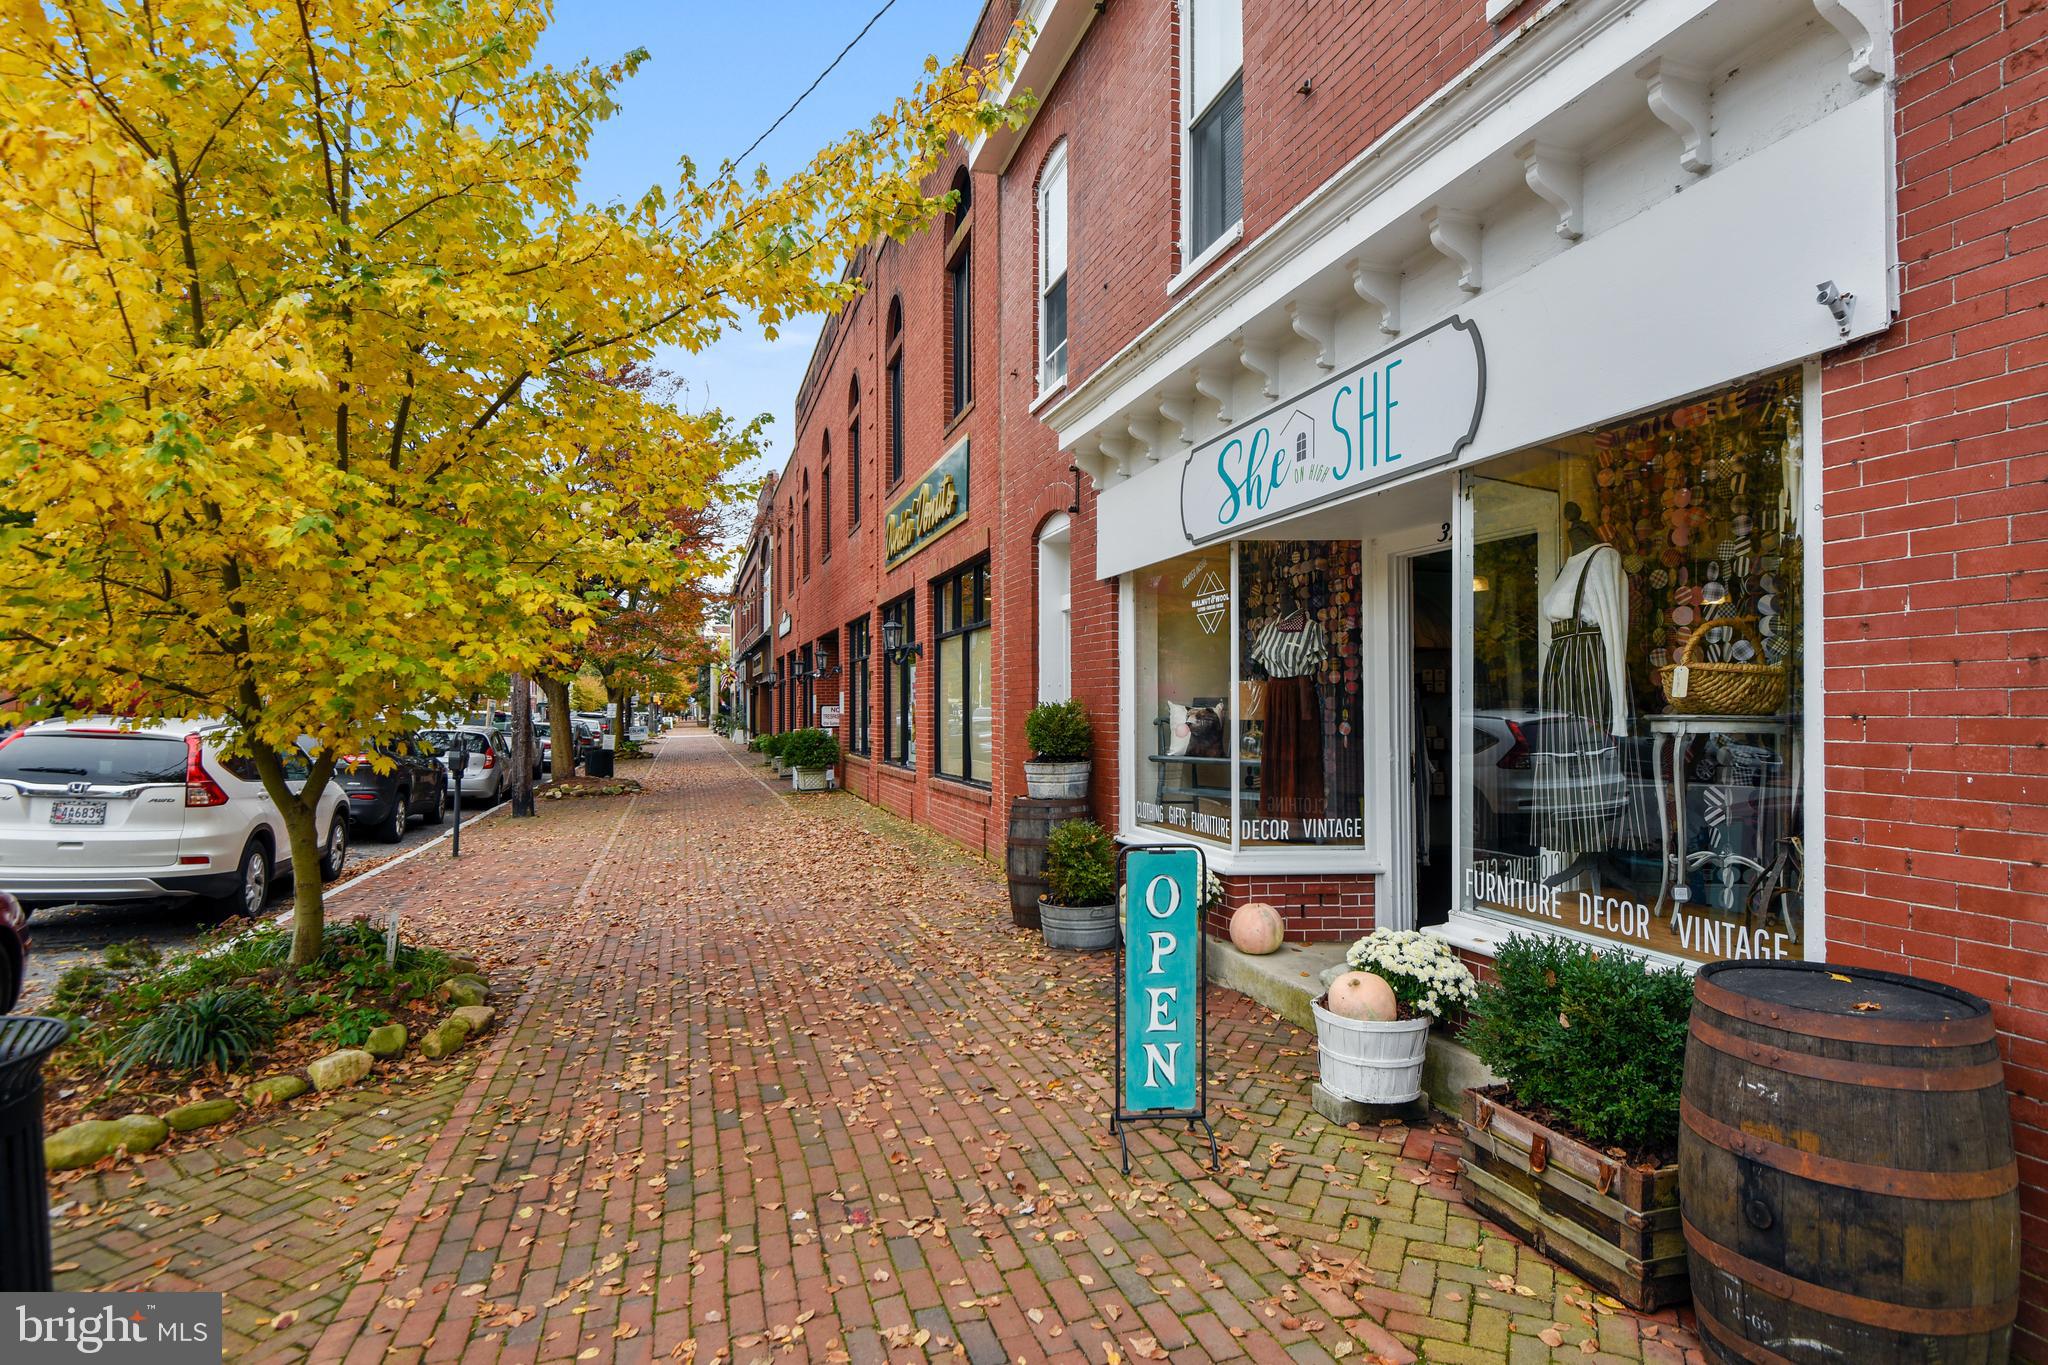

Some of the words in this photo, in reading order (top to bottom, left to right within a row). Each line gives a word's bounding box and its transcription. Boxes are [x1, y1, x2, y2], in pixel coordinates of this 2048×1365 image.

[1218, 427, 1292, 525] She
[1332, 359, 1403, 480] SHE
[1295, 465, 1305, 484] ON
[1309, 464, 1330, 483] HIGH
[1437, 522, 1452, 543] 3
[1136, 800, 1164, 823] CLOTHING
[1168, 805, 1187, 828] GIFTS
[1191, 811, 1231, 839] FURNITURE
[1241, 819, 1290, 840] DECOR
[1303, 818, 1362, 838] VINTAGE
[1465, 868, 1562, 920] FURNITURE
[1579, 892, 1650, 940] DECOR
[1677, 913, 1789, 960] VINTAGE
[1143, 873, 1182, 1089] OPEN
